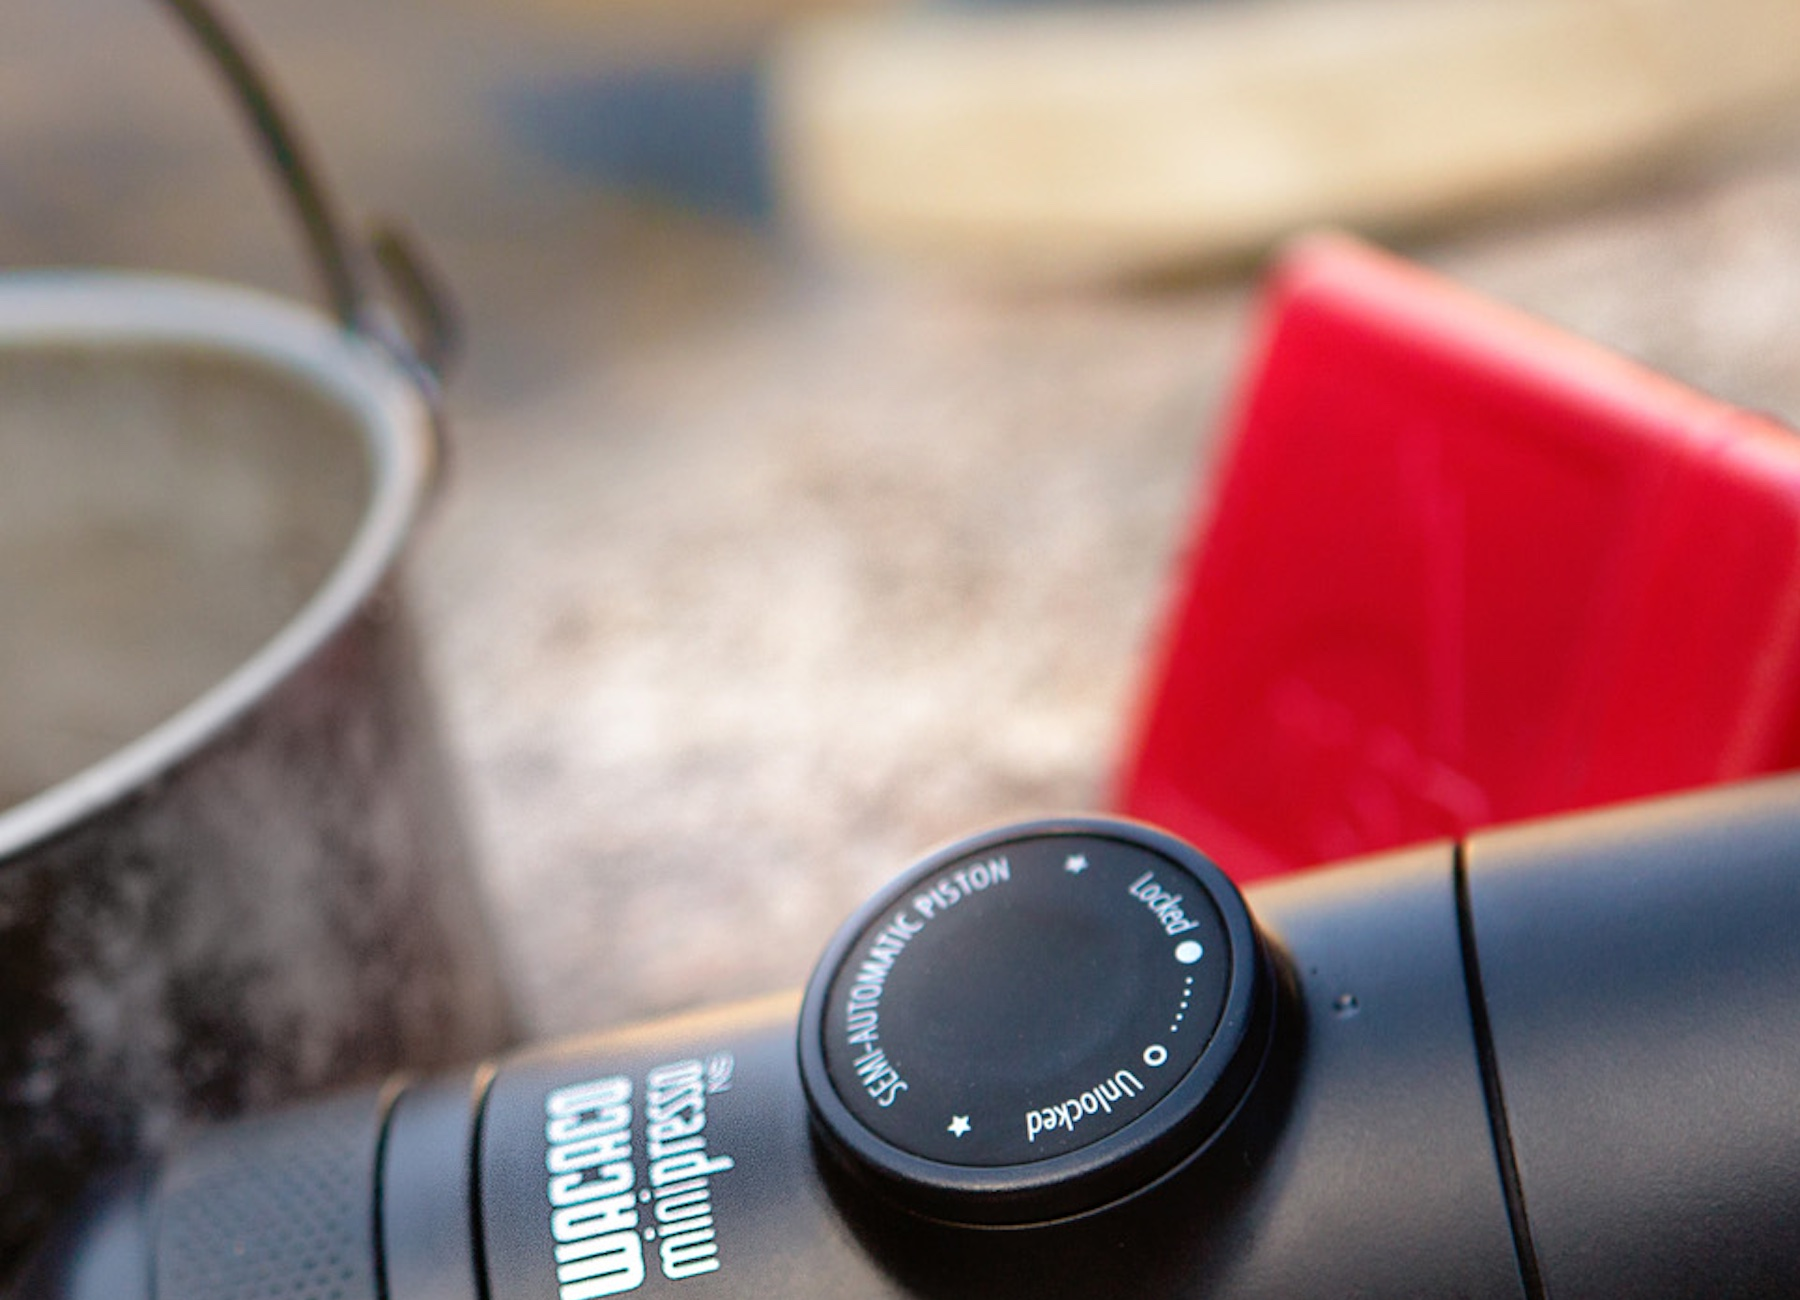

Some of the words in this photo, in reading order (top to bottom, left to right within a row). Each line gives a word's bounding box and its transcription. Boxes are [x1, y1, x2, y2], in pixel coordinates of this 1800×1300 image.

[1129, 872, 1199, 936] Locked
[846, 911, 923, 1108] SEMI-AUTOMATIC
[917, 857, 1011, 920] PISTON
[640, 1059, 735, 1281] minipresso
[1026, 1068, 1144, 1142] Unlocked
